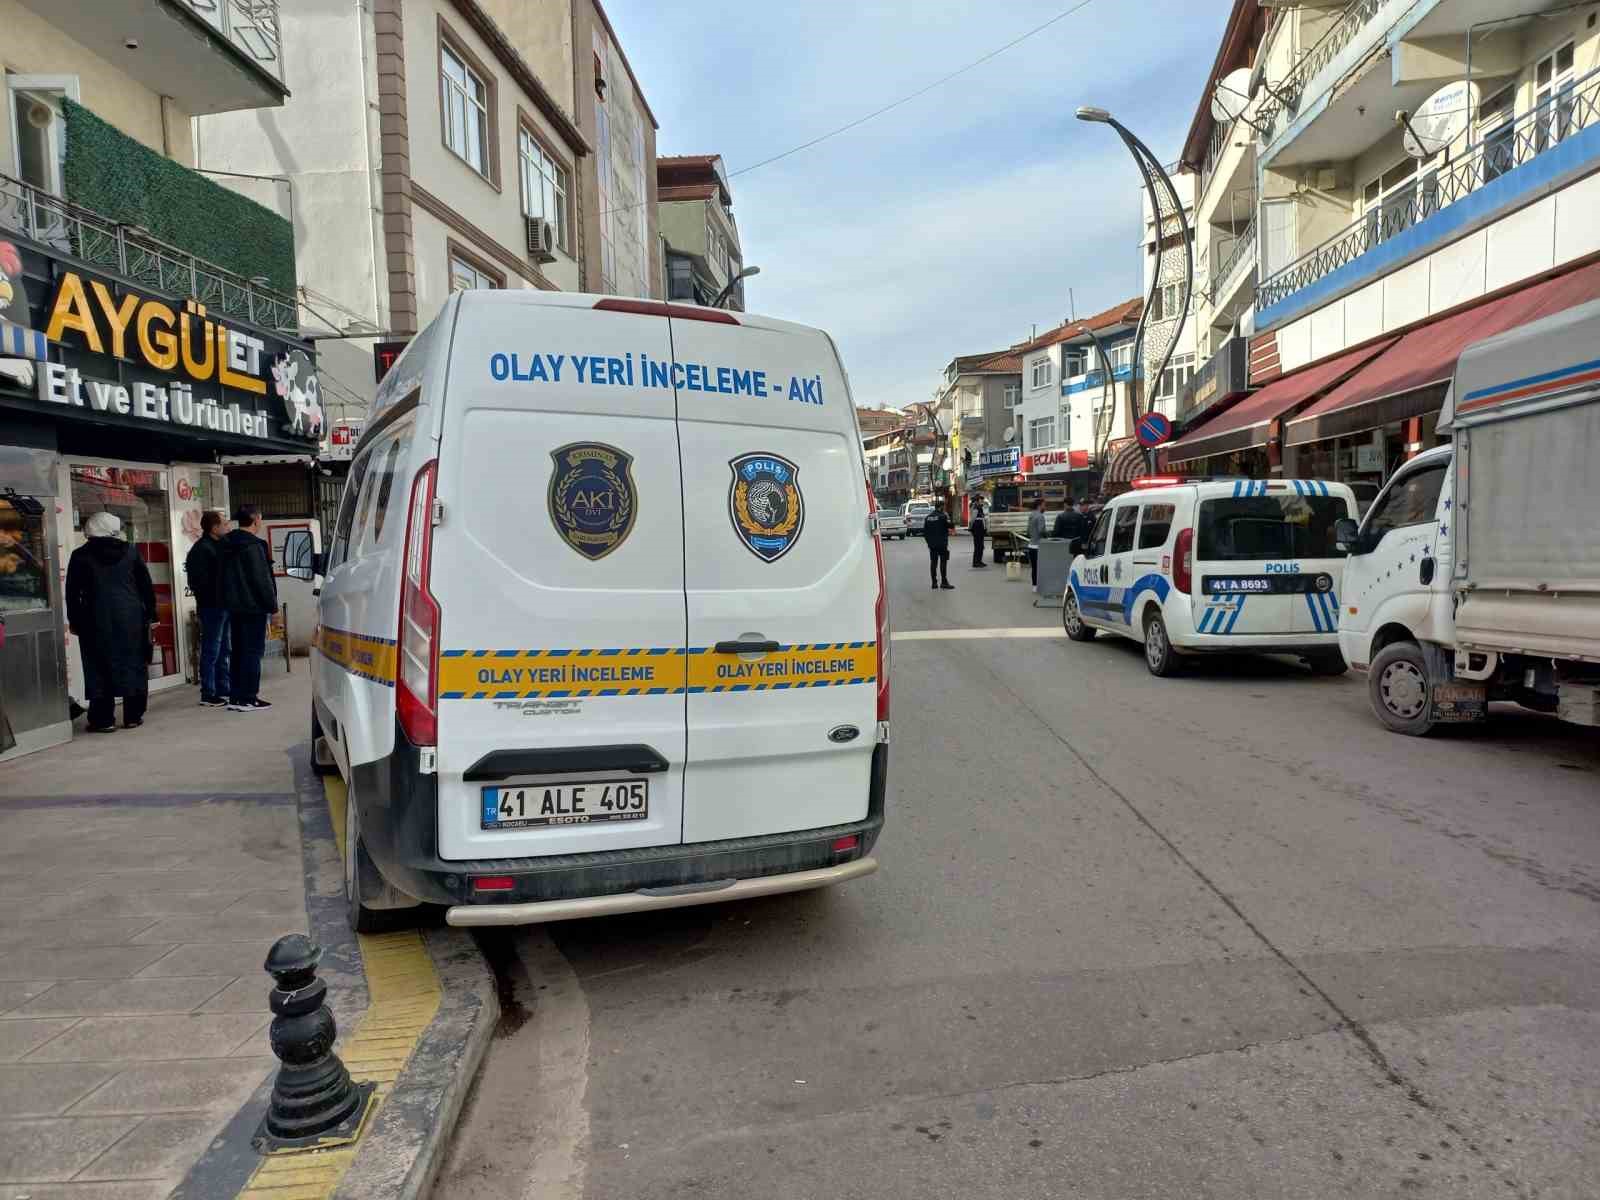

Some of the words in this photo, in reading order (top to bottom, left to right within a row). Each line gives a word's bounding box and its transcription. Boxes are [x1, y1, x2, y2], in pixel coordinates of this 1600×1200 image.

[47, 271, 266, 395] AYGÜL
[227, 329, 265, 375] ET
[490, 353, 565, 382] OLAY
[571, 352, 634, 386] YERİ
[641, 354, 768, 398] İNCELEME
[788, 375, 824, 405] AKİ
[37, 361, 84, 406] Et
[84, 381, 130, 414] ve
[132, 381, 169, 421] Et
[169, 380, 268, 438] Ürünleri
[1033, 451, 1067, 466] ECZANE
[572, 488, 614, 509] AKİ
[1213, 580, 1226, 589] 41
[1230, 580, 1239, 589] A
[478, 669, 523, 684] OLAY
[528, 664, 566, 683] YERİ
[572, 664, 655, 682] İNCELEME
[717, 664, 754, 678] OLAY
[759, 659, 788, 677] YERİ
[792, 659, 854, 675] İNCELEME
[486, 806, 497, 815] TR
[500, 790, 525, 817] 41
[541, 787, 586, 815] ALE
[600, 784, 643, 811] 405
[549, 815, 590, 825] ESOTO
